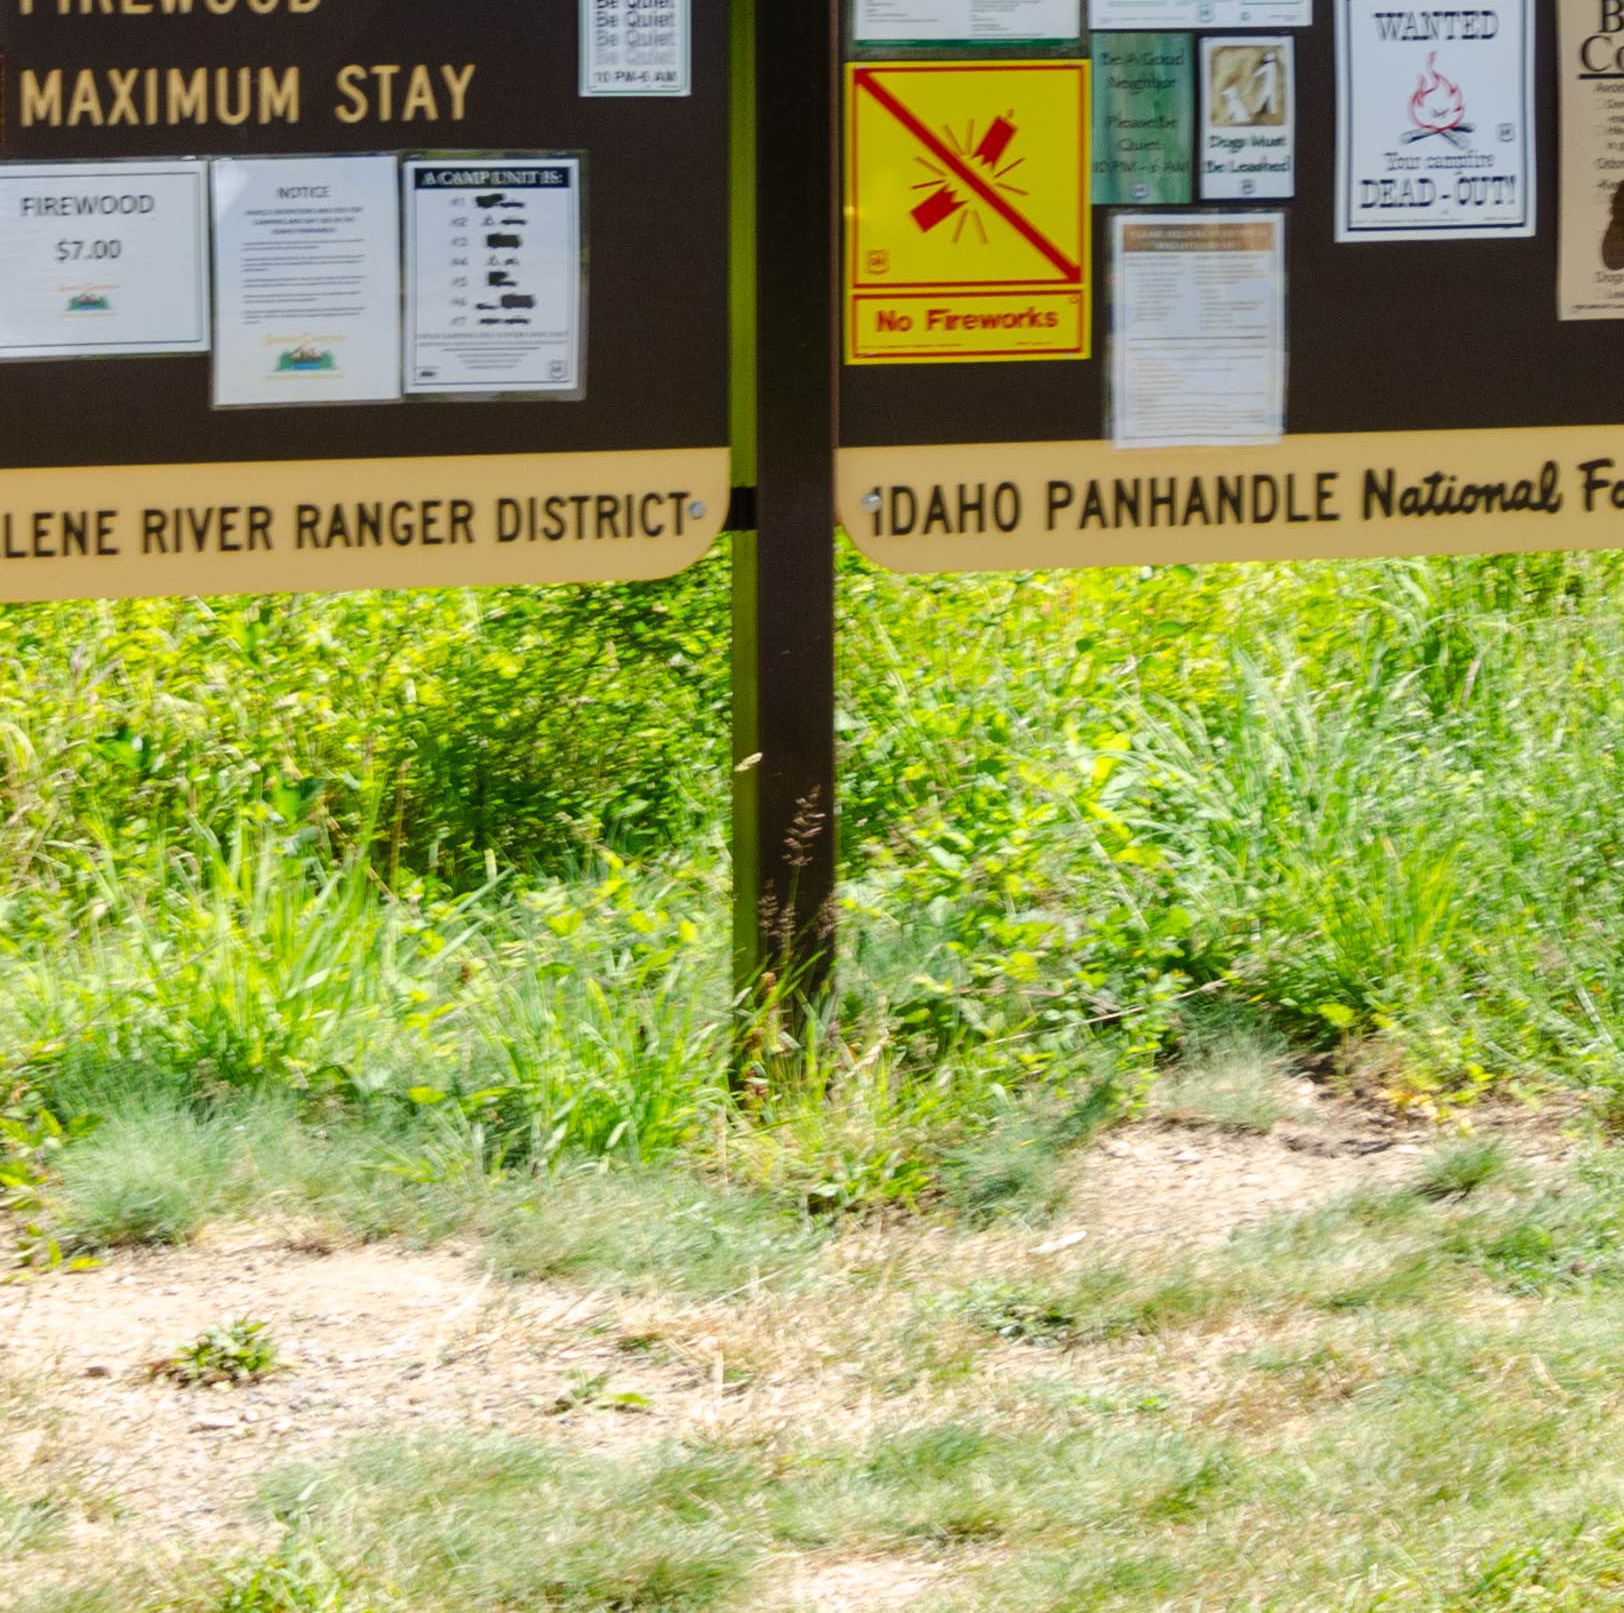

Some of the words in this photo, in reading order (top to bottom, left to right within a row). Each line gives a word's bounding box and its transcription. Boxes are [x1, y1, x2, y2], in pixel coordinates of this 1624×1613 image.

[595, 10, 619, 27] Be
[626, 10, 676, 28] Quiet
[1372, 9, 1501, 41] WANTED
[19, 65, 301, 127] MAXIMUM
[333, 64, 476, 124] STAY
[437, 170, 489, 185] CAMP
[492, 169, 539, 184] UNIT
[277, 186, 331, 199] NOTICE
[20, 194, 155, 217] FIREWOOD
[55, 239, 123, 262] $7.00
[876, 309, 914, 332] No
[925, 306, 1059, 331] Fireworks
[872, 481, 1021, 537] IDAHO
[1047, 472, 1340, 532] PANHANDLE
[1361, 459, 1564, 521] National
[142, 505, 274, 555] RIVER
[296, 498, 475, 549] RANGER
[498, 491, 690, 543] DISTRICT
